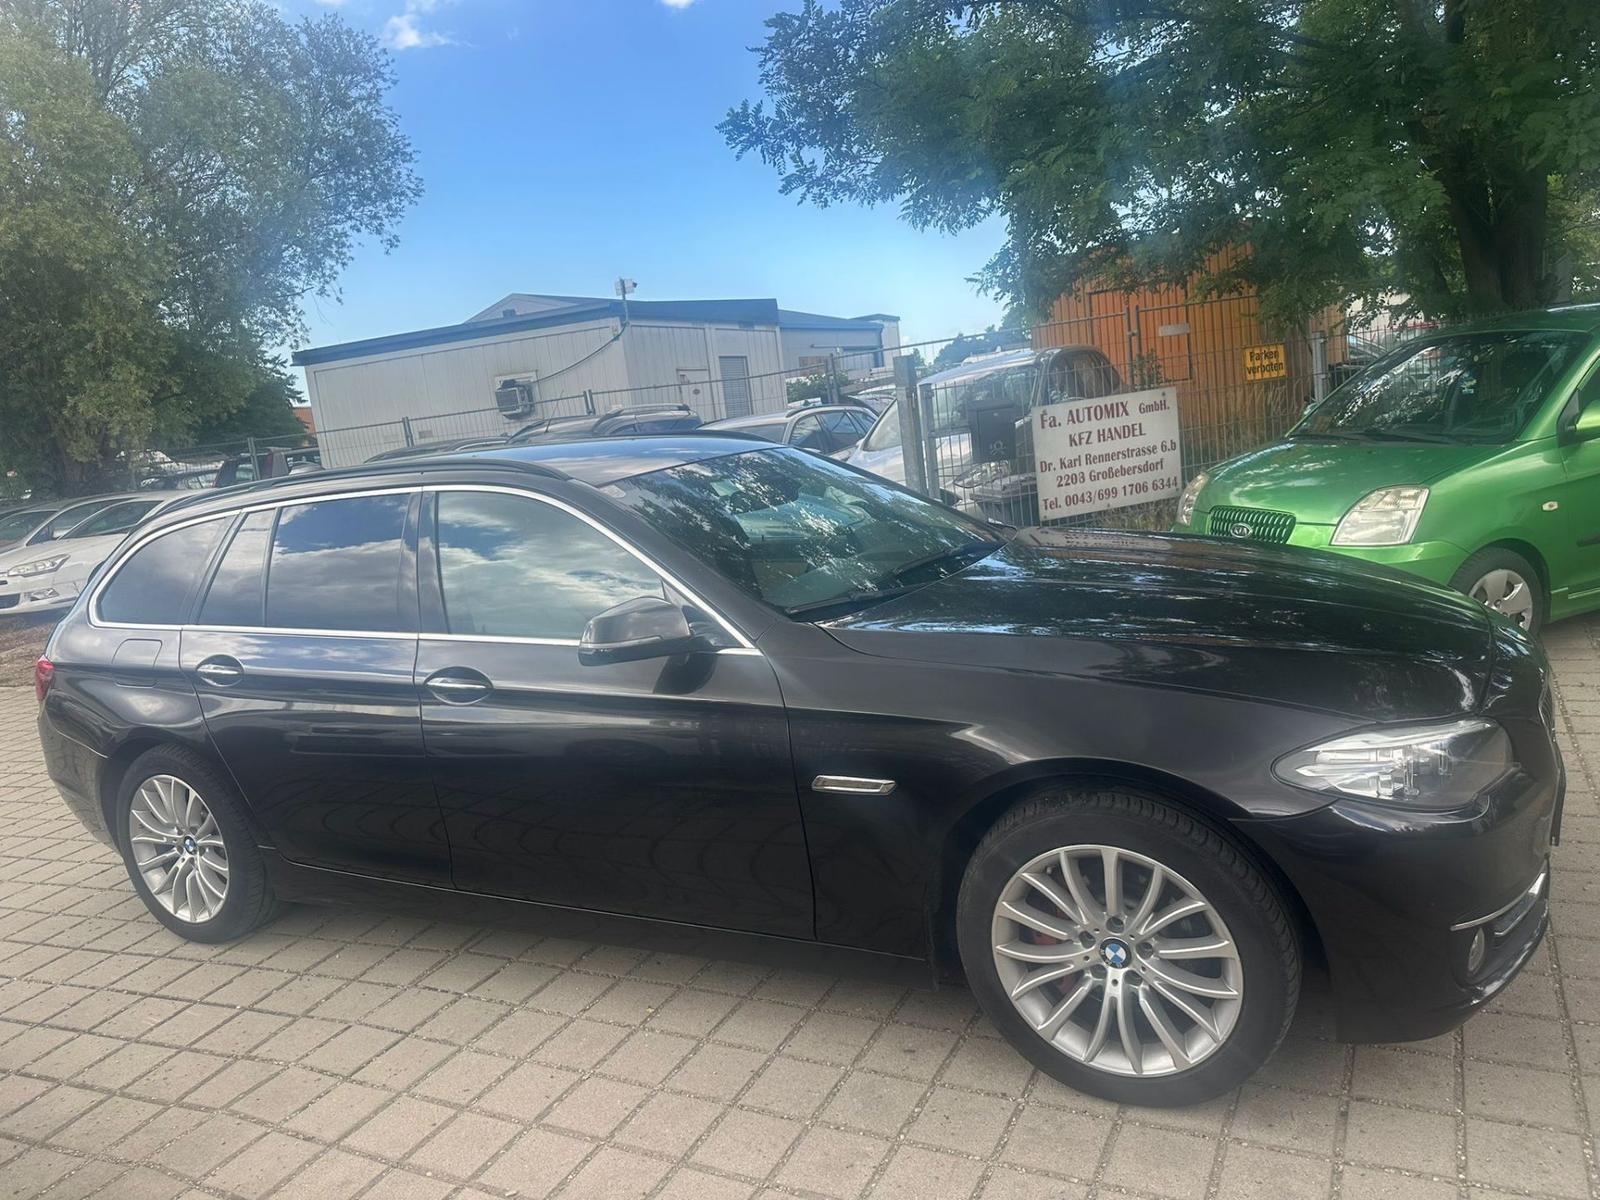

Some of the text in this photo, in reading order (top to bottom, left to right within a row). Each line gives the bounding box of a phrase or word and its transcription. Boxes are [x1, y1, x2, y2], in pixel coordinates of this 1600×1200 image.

[1250, 350, 1279, 361] Parken
[1040, 400, 1170, 429] Fa. AUTOMIX GmbH.
[1069, 422, 1146, 447] KFZ HANDEL
[1040, 440, 1177, 473] Dr. Karl Rennerstrasse 6.b
[1056, 458, 1164, 488] 2203 Großebersdorf
[1042, 476, 1178, 511] Tel. 0043/699 1706 6344
